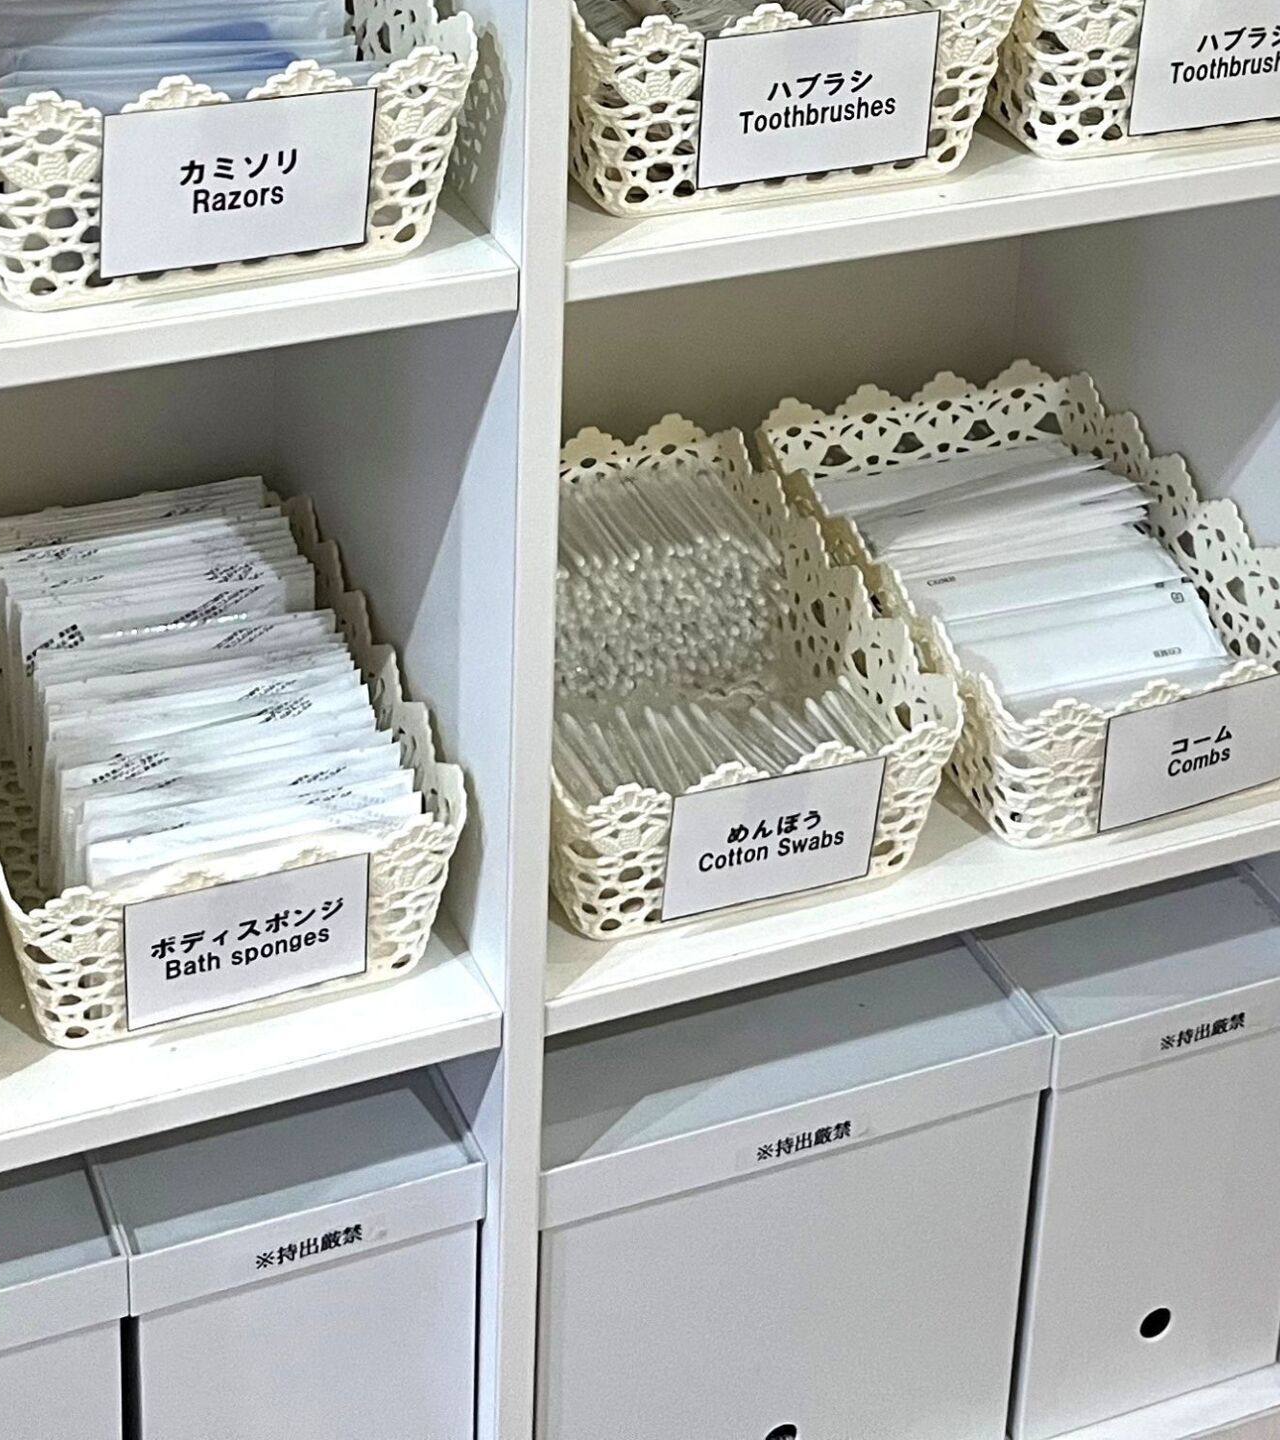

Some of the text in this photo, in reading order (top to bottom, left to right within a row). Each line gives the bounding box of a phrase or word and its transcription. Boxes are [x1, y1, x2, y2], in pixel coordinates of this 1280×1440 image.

[767, 69, 873, 102] ハブラシ
[739, 96, 896, 134] Toothbrushes
[179, 148, 299, 188] カミソリ
[192, 183, 284, 214] Razors
[1171, 724, 1233, 756] コーム
[1166, 745, 1230, 777] Combs
[727, 811, 821, 843] めんぼう
[699, 830, 844, 872] Cotton Swabs
[150, 897, 344, 961] ボディスポンジ
[165, 926, 330, 980] Bath sponges
